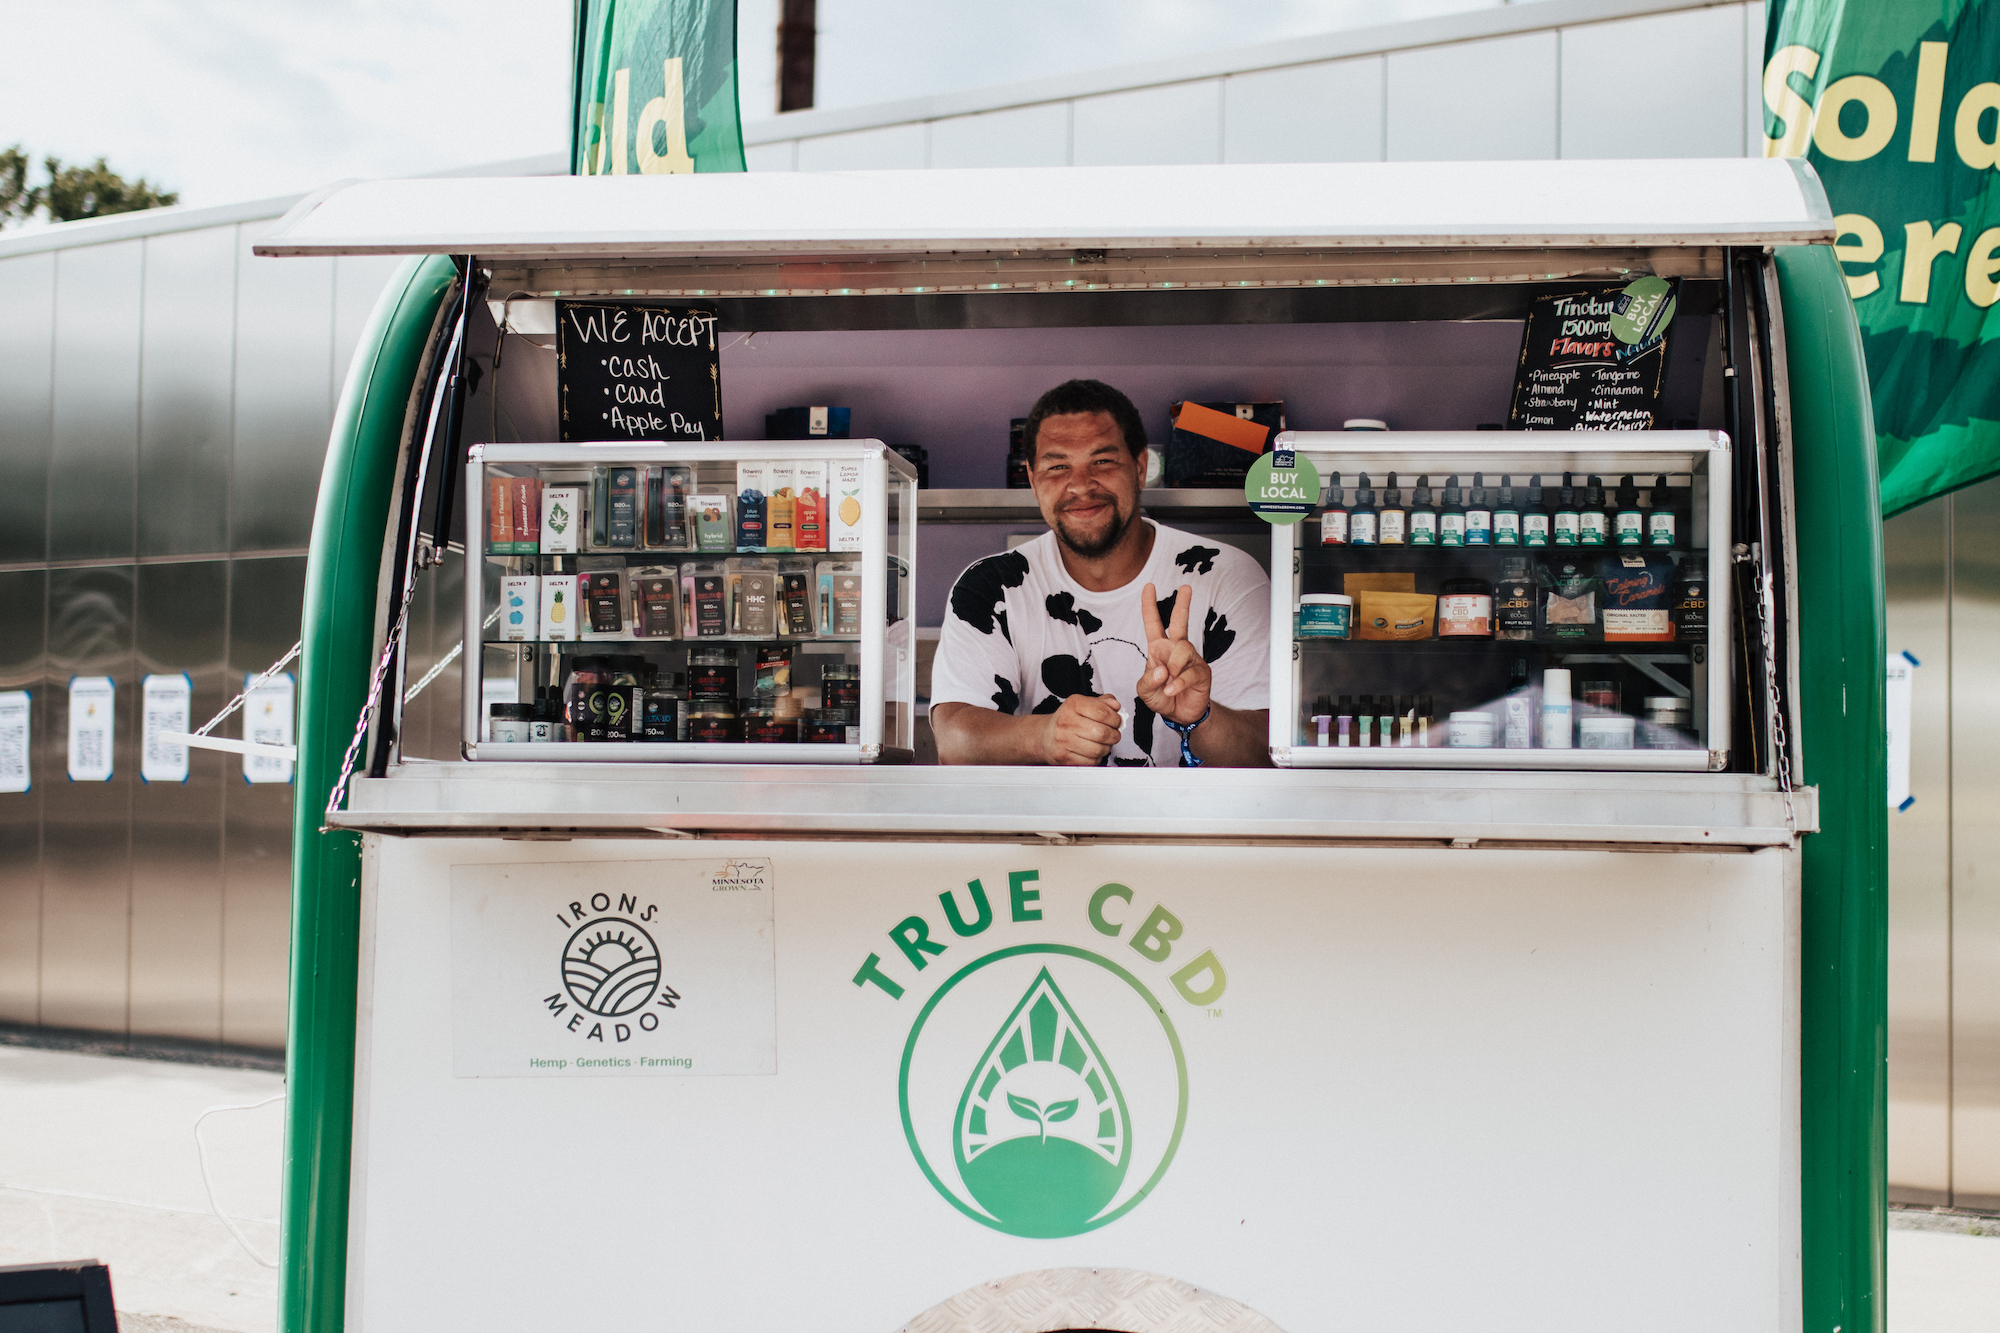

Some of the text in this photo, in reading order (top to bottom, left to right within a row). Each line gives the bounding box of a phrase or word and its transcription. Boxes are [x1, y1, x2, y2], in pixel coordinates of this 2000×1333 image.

[1626, 294, 1646, 322] BUY
[1632, 293, 1662, 333] LOCAL
[569, 309, 718, 347] WE ACCEPT
[1560, 319, 1612, 340] 1500mg
[1550, 337, 1616, 358] Flavors
[1532, 369, 1581, 385] Pineapple
[1595, 368, 1641, 386] Tangerine
[1531, 384, 1565, 396] Almond
[1594, 384, 1644, 396] Cinnamon
[1527, 397, 1578, 412] Strawberry
[1593, 398, 1620, 410] Mint
[611, 405, 706, 441] Apple Pay
[1585, 408, 1651, 423] Watermelon
[1270, 472, 1298, 484] BUY
[1260, 486, 1306, 499] LOCAL
[1606, 576, 1648, 594] Calming
[1618, 585, 1666, 606] Caramels
[556, 892, 658, 928] IRONS
[851, 869, 1227, 1006] TRUE CBD
[544, 985, 682, 1042] MEADOW
[1206, 1008, 1222, 1018] TM
[530, 1056, 692, 1070] Hemp Genetics Farming
